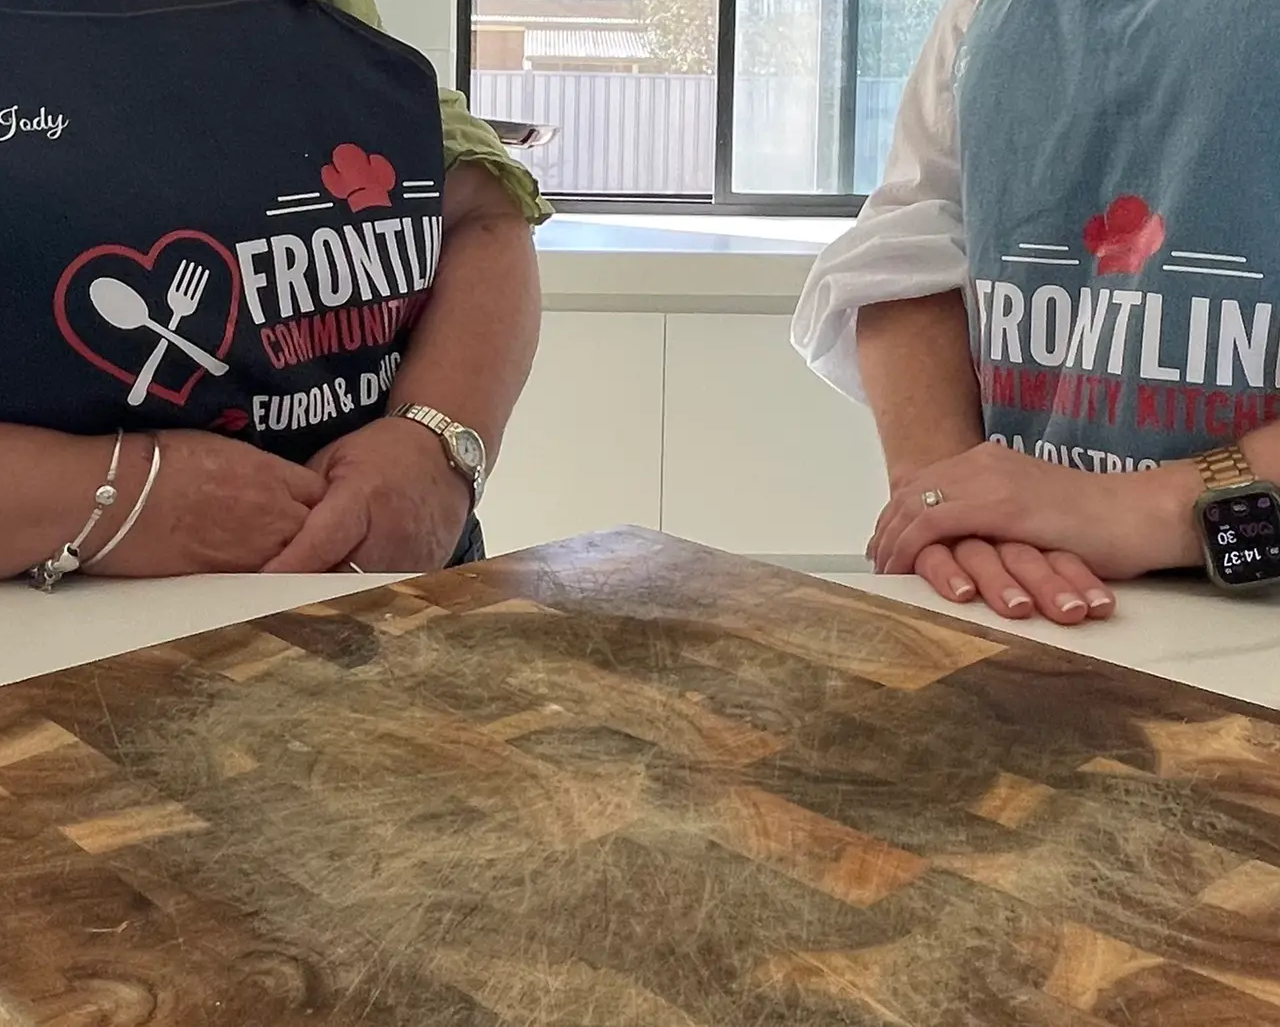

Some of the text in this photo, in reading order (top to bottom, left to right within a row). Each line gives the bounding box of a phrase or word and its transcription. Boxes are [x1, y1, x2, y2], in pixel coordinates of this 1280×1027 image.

[252, 383, 337, 432] EUROA
[334, 377, 355, 414] &
[1217, 530, 1237, 545] 30
[1223, 548, 1262, 567] 14:37
